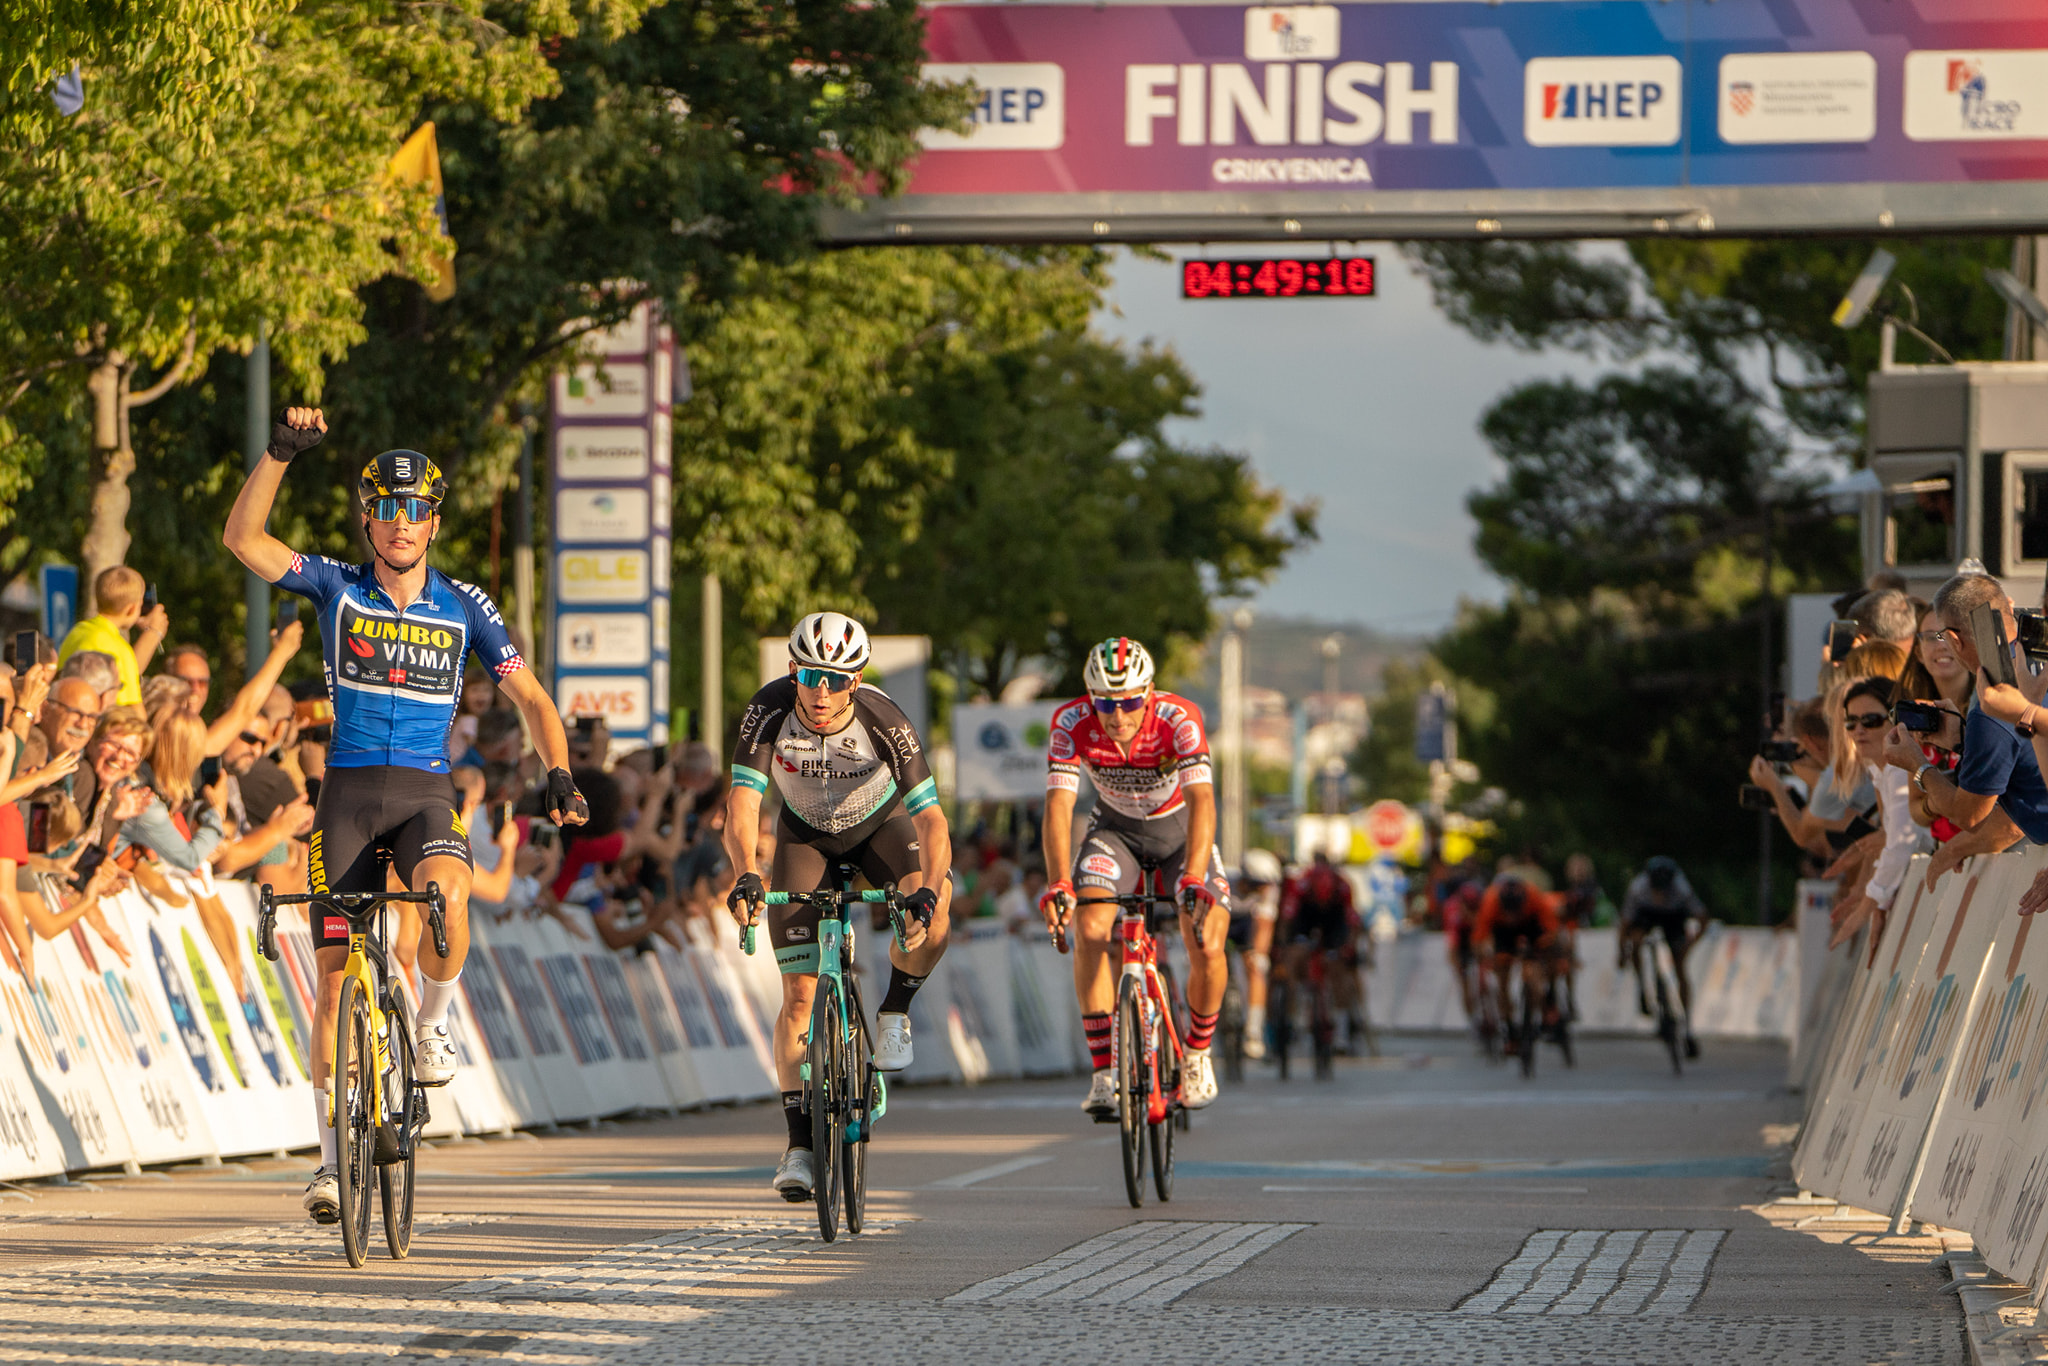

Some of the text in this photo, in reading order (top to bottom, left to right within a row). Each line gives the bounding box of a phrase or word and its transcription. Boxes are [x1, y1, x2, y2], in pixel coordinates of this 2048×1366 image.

[1125, 61, 1460, 146] FINISH
[1584, 83, 1663, 118] HEP
[1212, 158, 1373, 183] CRIKVENICA
[1184, 257, 1373, 298] 04:49:18
[394, 456, 412, 478] OLAV
[469, 586, 504, 627] HEP
[348, 616, 453, 649] JUMBO
[383, 642, 452, 671] VISMA
[361, 672, 384, 681] Better
[567, 690, 636, 715] AVIS
[741, 704, 767, 742] ALULA
[784, 744, 817, 753] Bianchi
[886, 726, 913, 766] ALULA
[801, 760, 833, 770] BIKE
[310, 829, 330, 895] JUMBO
